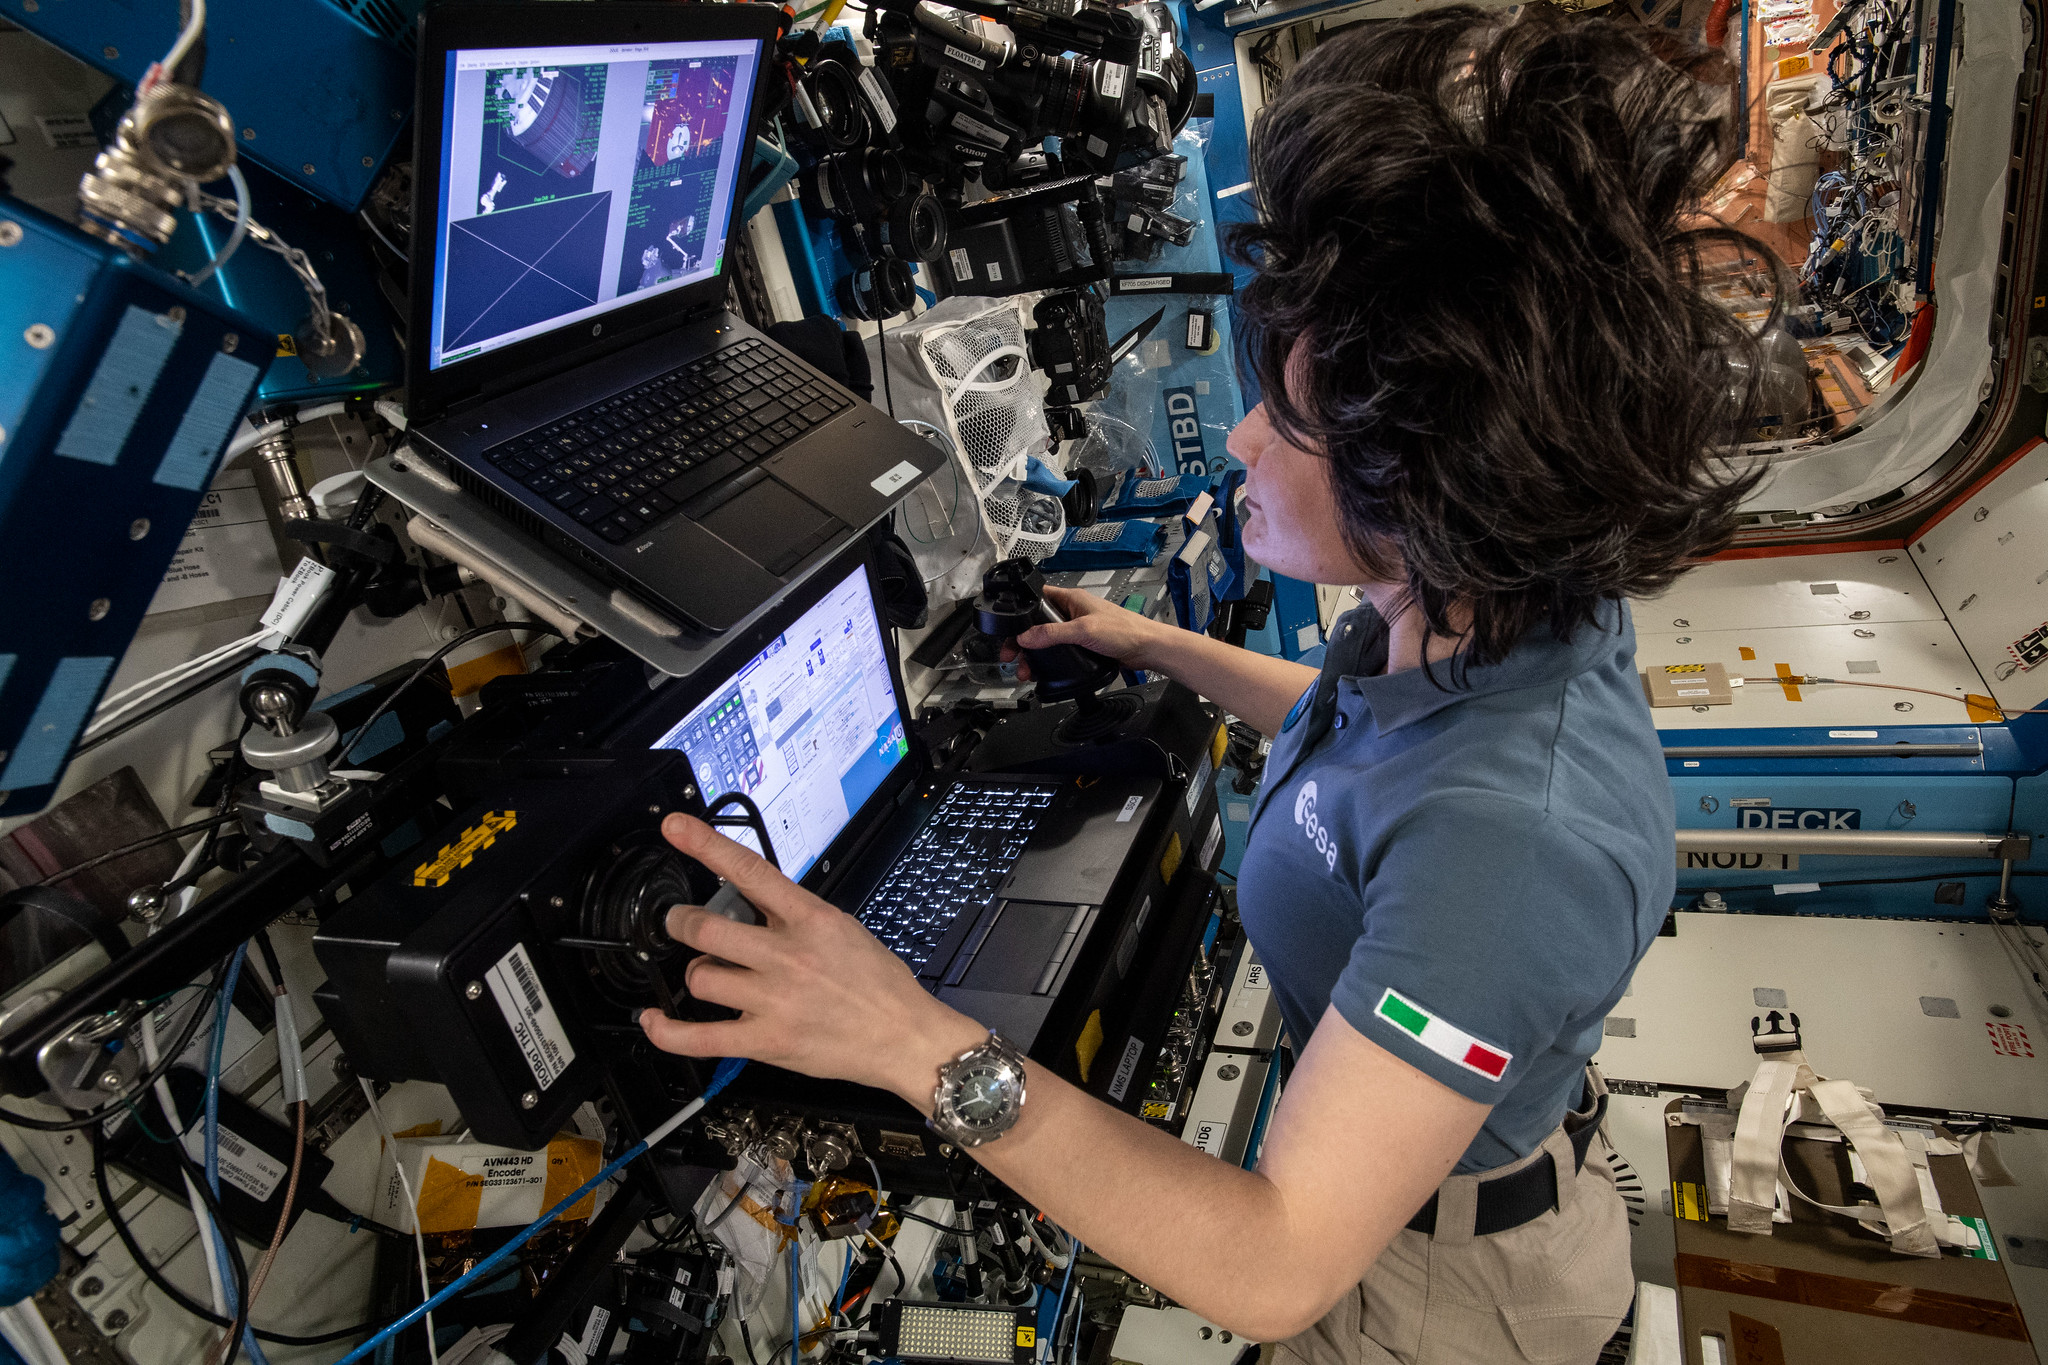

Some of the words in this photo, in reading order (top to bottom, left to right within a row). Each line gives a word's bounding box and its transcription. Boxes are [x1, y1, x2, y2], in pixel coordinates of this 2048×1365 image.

[947, 47, 976, 64] FLOATER
[955, 144, 988, 158] Canon
[1167, 392, 1206, 477] STBD
[290, 566, 306, 584] ZBook
[302, 561, 317, 580] ZBook
[312, 564, 325, 576] P1
[290, 579, 305, 596] Power
[279, 596, 294, 613] Cable
[1742, 809, 1857, 829] DECK
[1687, 852, 1763, 869] NOD
[1248, 964, 1262, 985] ARS
[513, 1020, 531, 1049] THC
[1113, 1073, 1125, 1096] NMS
[1120, 1042, 1139, 1074] LAPTOP
[483, 1158, 520, 1167] AVN443
[521, 1156, 534, 1166] HD
[552, 1158, 563, 1166] Qty
[232, 1173, 250, 1187] Power
[487, 1168, 526, 1178] Encoder
